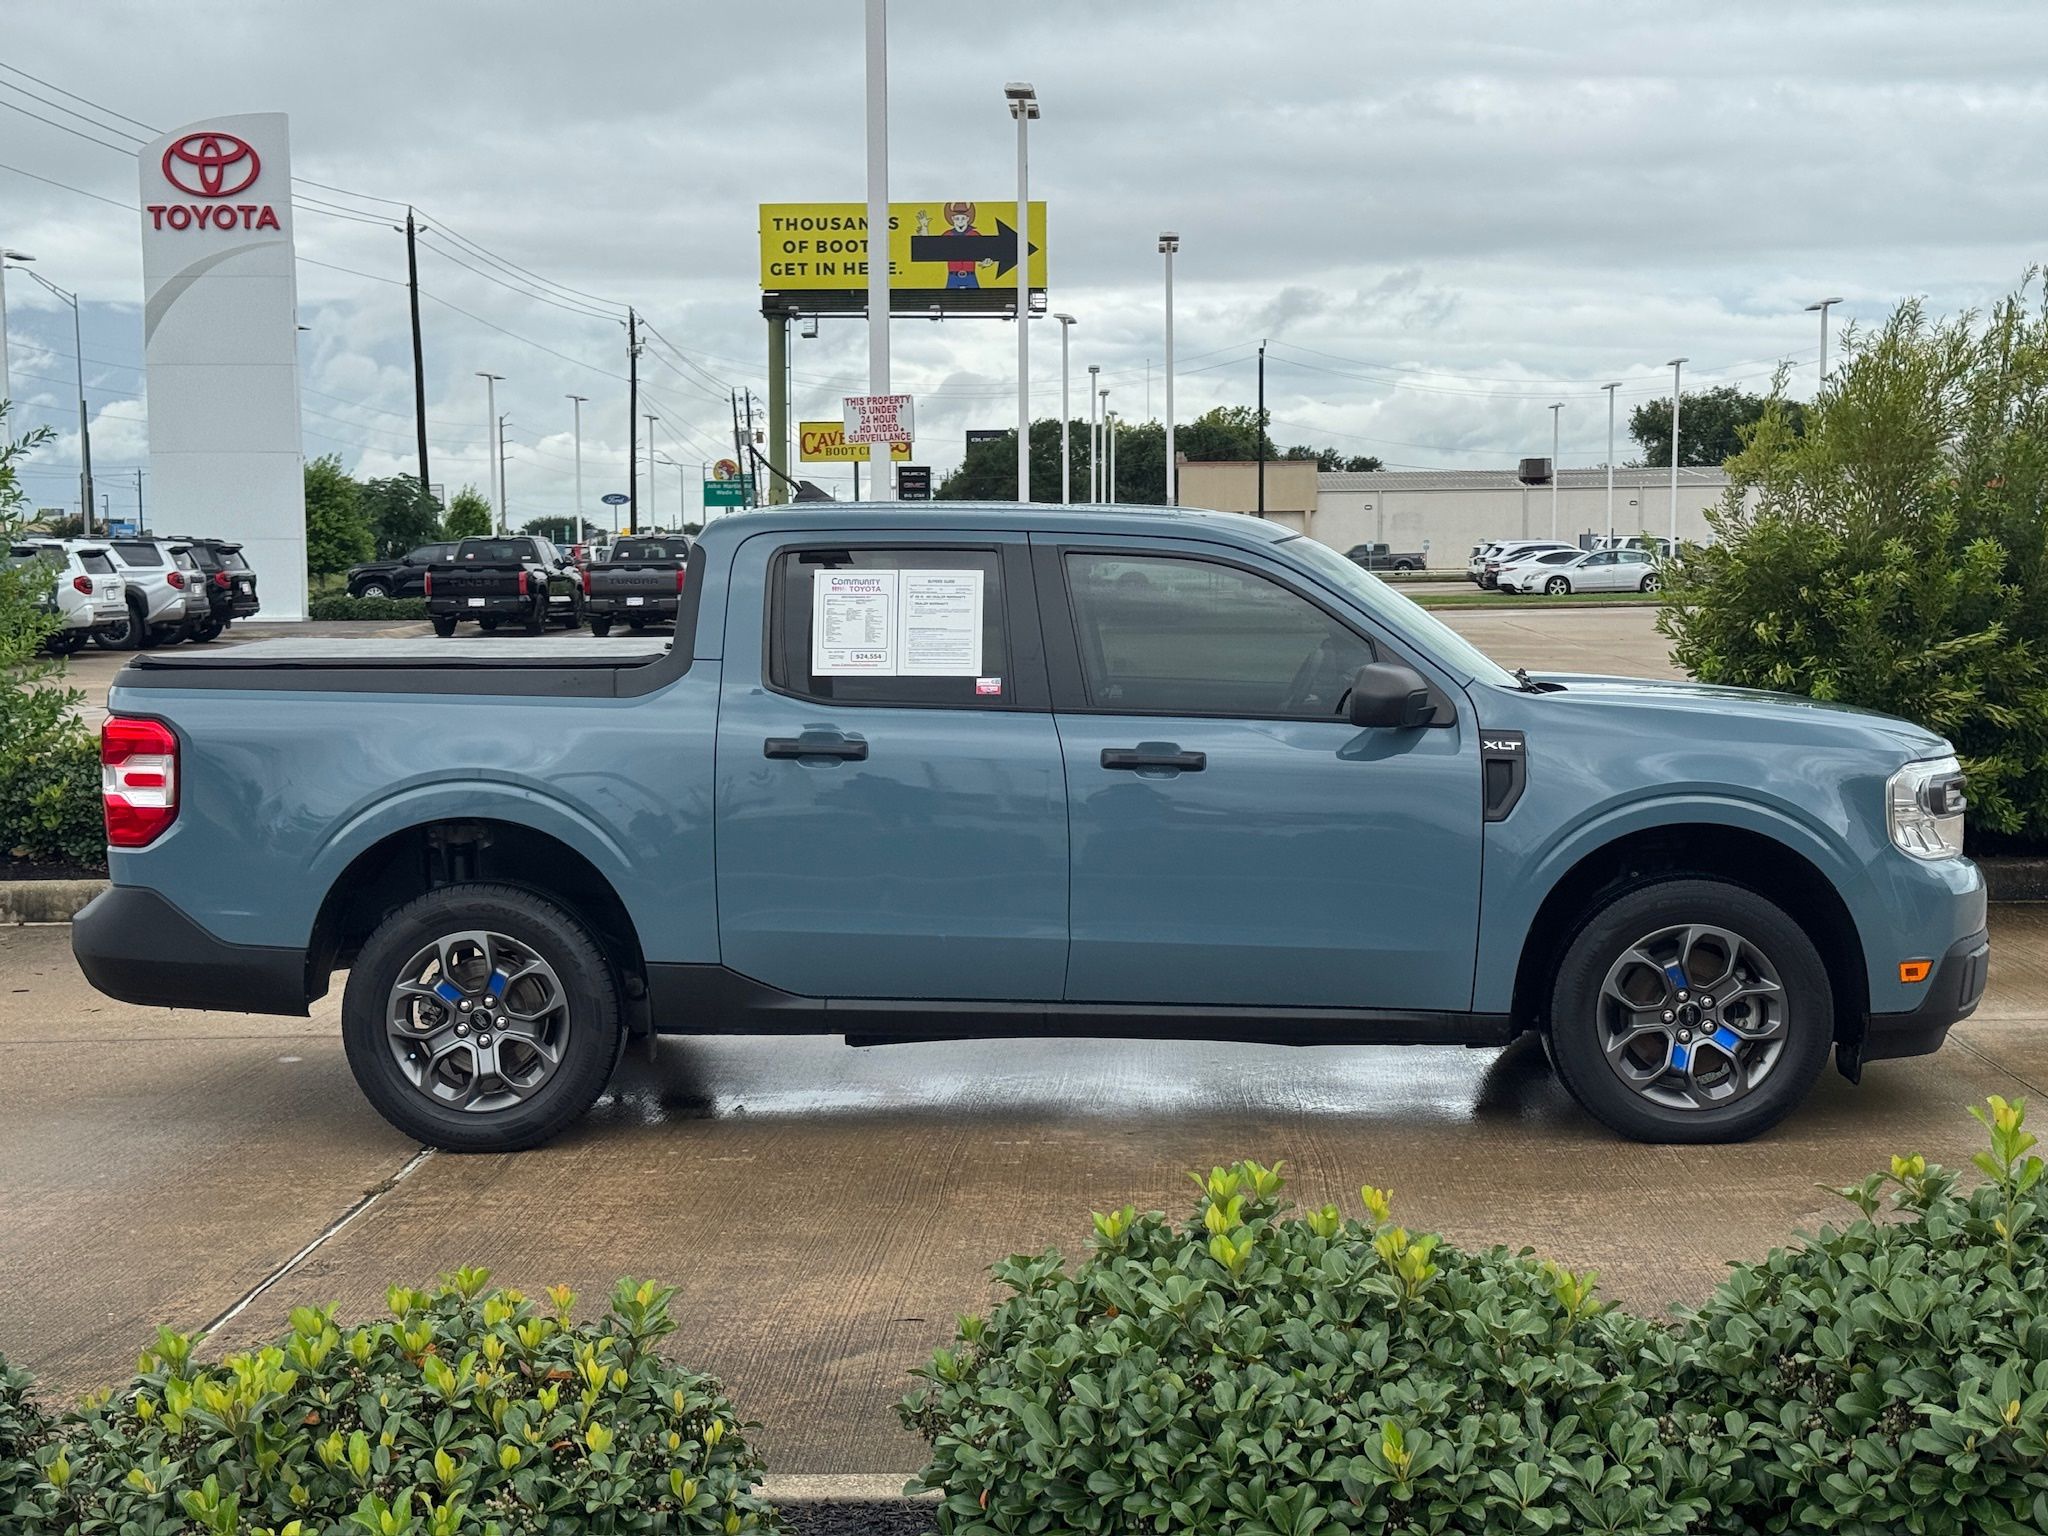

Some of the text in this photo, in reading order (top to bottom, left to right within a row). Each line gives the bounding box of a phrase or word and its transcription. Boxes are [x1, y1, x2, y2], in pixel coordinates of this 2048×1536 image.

[146, 204, 281, 231] TOYOTA
[772, 217, 899, 231] THOUSANS
[783, 240, 869, 253] OF BOOT
[770, 262, 902, 276] GET IN HEE.
[845, 395, 910, 407] THIS PROPERTY
[858, 405, 898, 415] IS UNDER
[861, 414, 897, 424] 24 HOUR
[860, 424, 898, 433] HD VIDEO
[848, 432, 911, 443] SURVEILLANCE
[826, 447, 856, 456] BOOT
[608, 577, 659, 585] TUNDRA
[1483, 740, 1522, 751] XLT
